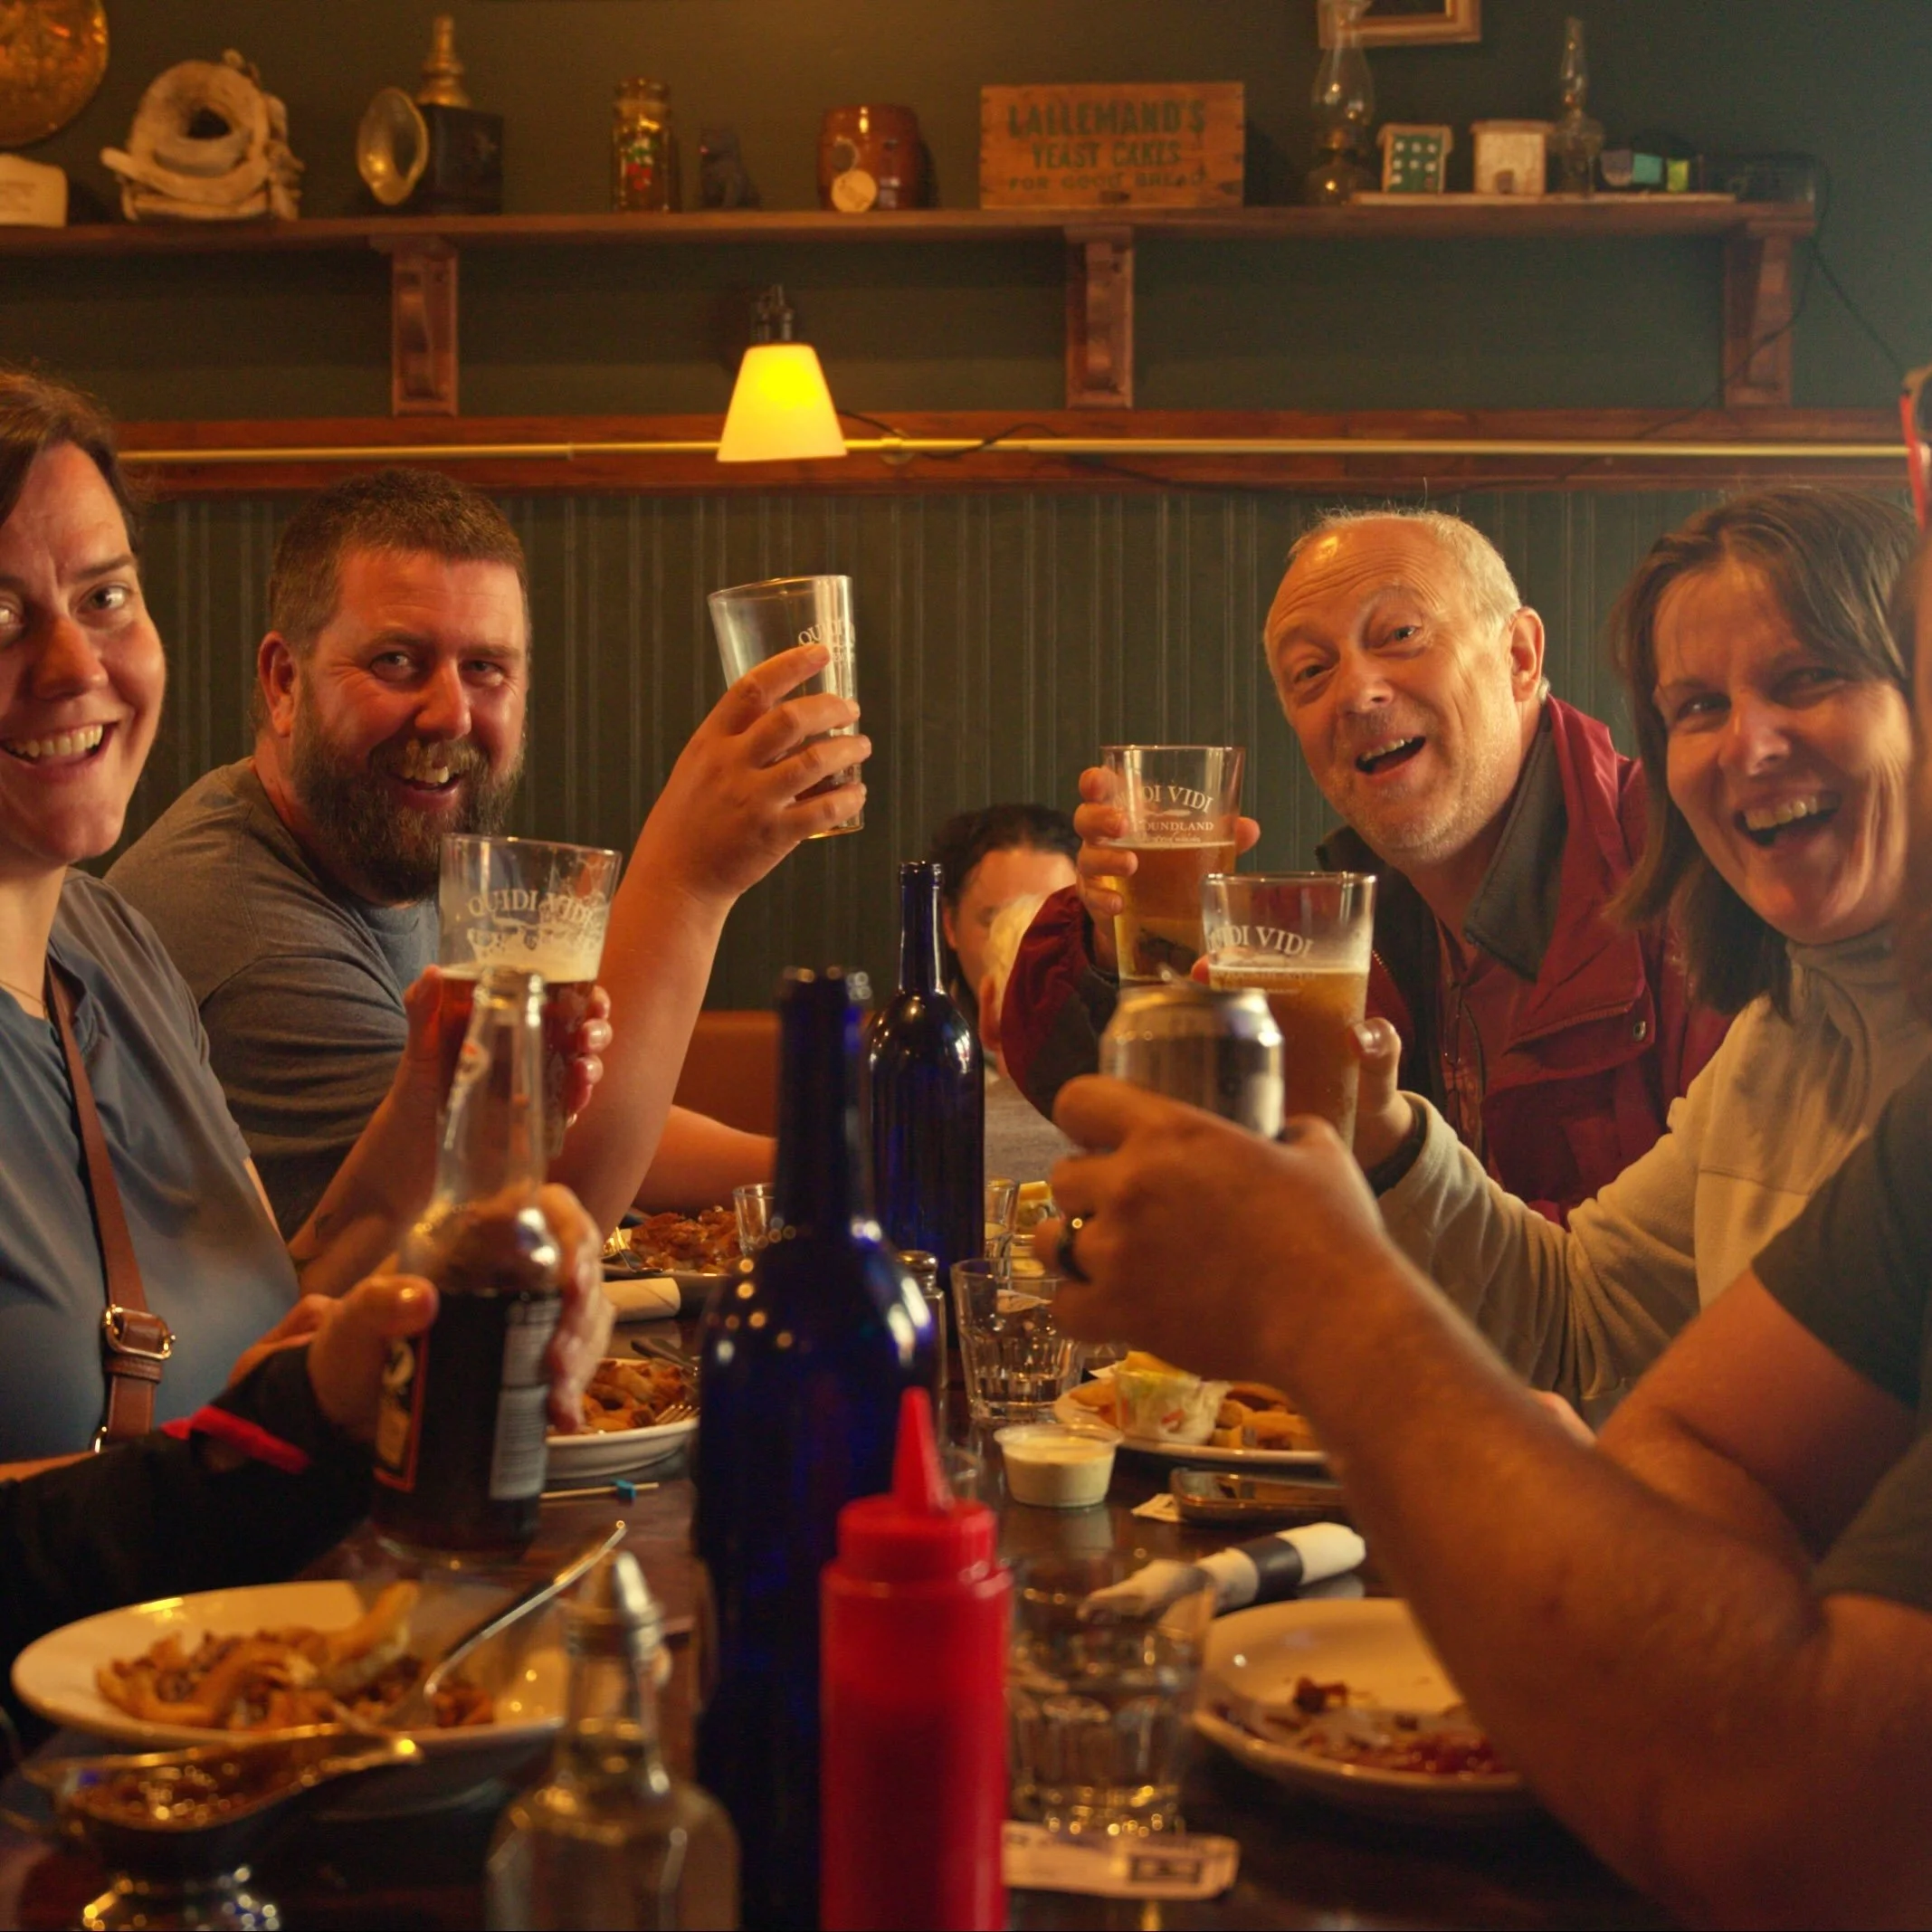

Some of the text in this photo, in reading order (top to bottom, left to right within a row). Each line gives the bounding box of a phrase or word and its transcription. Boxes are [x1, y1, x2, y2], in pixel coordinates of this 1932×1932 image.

[1007, 100, 1206, 138] LALLEMAND'S
[1031, 139, 1182, 170] YEAST CAKES
[1167, 785, 1214, 814] VIDI
[1255, 926, 1315, 959] VIDI
